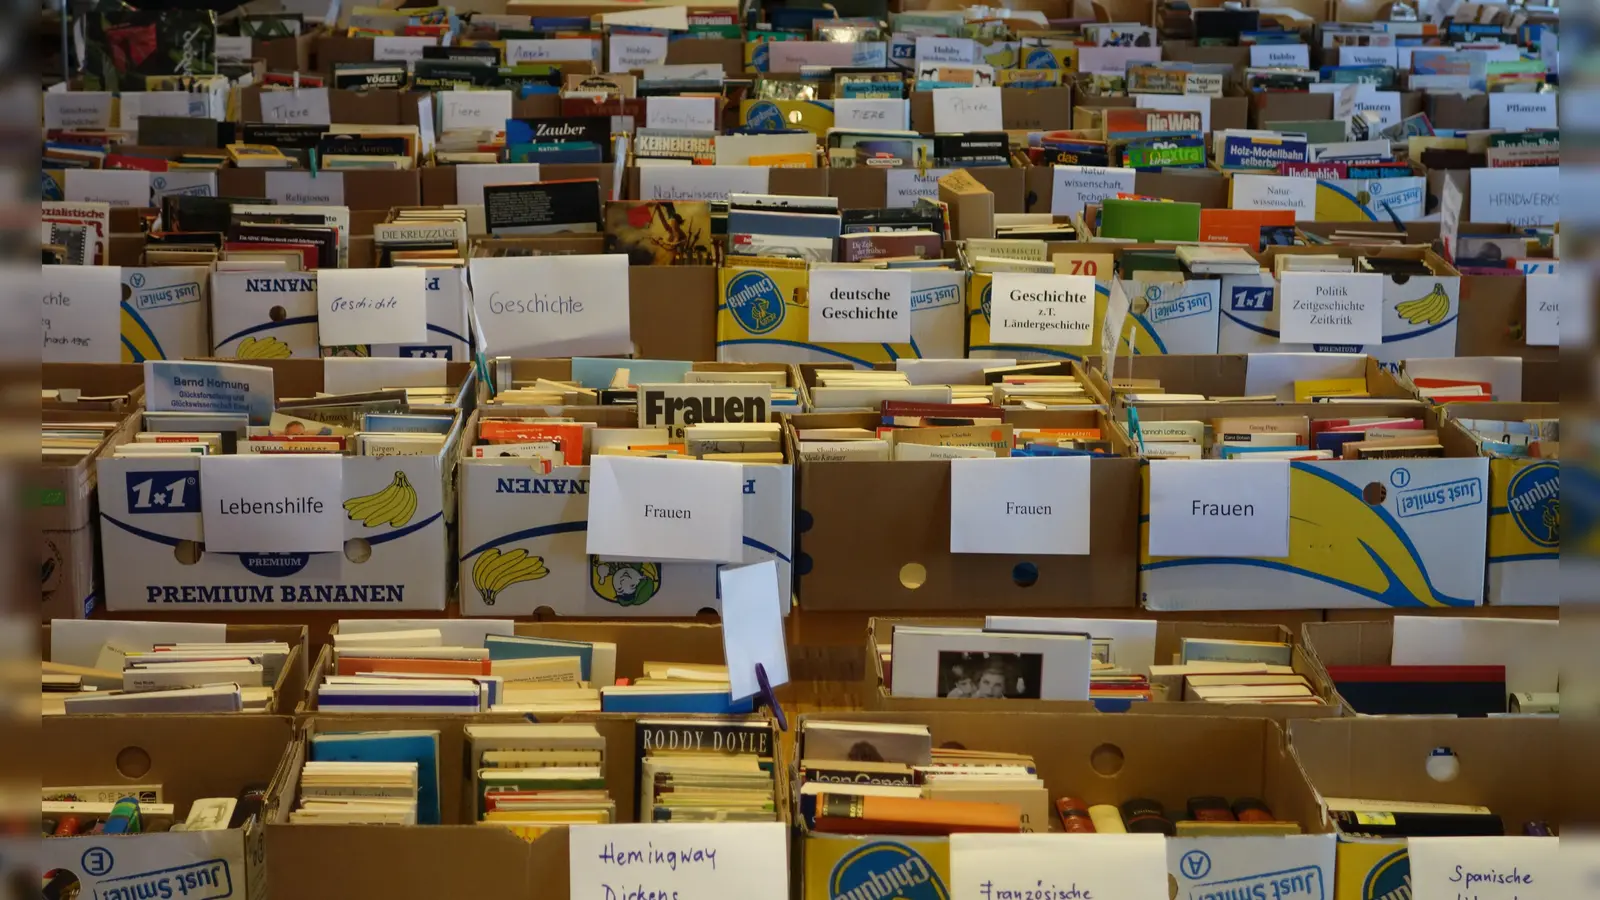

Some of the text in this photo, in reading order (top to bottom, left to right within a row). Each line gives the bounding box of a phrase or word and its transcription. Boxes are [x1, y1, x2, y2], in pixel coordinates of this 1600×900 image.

[1269, 53, 1296, 61] Hobby
[366, 74, 398, 84] VÖGEL
[272, 105, 309, 119] Tiere
[450, 102, 481, 118] Tiere
[852, 109, 885, 120] TIERE
[1506, 104, 1547, 113] Pflanzen
[536, 122, 586, 137] Zauber
[1146, 113, 1200, 132] Die Welt
[1057, 151, 1078, 164] das
[1230, 144, 1304, 160] Holz-Modellbahn
[1081, 166, 1106, 176] Natur
[285, 193, 330, 204] Religionen
[898, 187, 938, 197] wissensc
[382, 227, 458, 240] DIE KREUZZÜGE
[246, 278, 318, 292] NANEN
[1315, 285, 1349, 297] Politik
[139, 284, 197, 307] Just Smile!
[727, 277, 775, 309] Chiquita
[829, 287, 892, 301] deutsche
[911, 286, 958, 307] Just Smil
[1009, 289, 1087, 304] Geschichte
[330, 296, 398, 313] Geschichte
[489, 291, 585, 315] Geschichte
[1189, 295, 1208, 310] Just
[1292, 299, 1366, 313] Zeitgeschichte
[821, 306, 898, 320] Geschichte
[1038, 307, 1057, 317] z.T.
[1003, 319, 1091, 332] Ländergeschichte
[173, 375, 250, 392] Bernd Hornung
[179, 390, 233, 402] Glücksforschung
[646, 390, 766, 425] Frauen
[1163, 428, 1187, 438] Lothrop
[495, 478, 589, 495] NANEN
[220, 496, 324, 515] Lebenshilfe
[1401, 482, 1477, 514] Just Smile!
[644, 504, 692, 520] Frauen
[1006, 501, 1053, 515] Frauen
[1192, 500, 1255, 517] Frauen
[248, 557, 301, 567] PREMIUM
[147, 585, 405, 603] PREMIUM BANANEN
[643, 729, 768, 753] RODDY DOYLE
[90, 852, 104, 872] E
[599, 841, 717, 871] Hemingway
[1187, 856, 1205, 875] A
[180, 865, 221, 896] Just
[1448, 864, 1534, 889] Spanische
[601, 883, 680, 900] Dickens
[1270, 871, 1316, 900] Just
